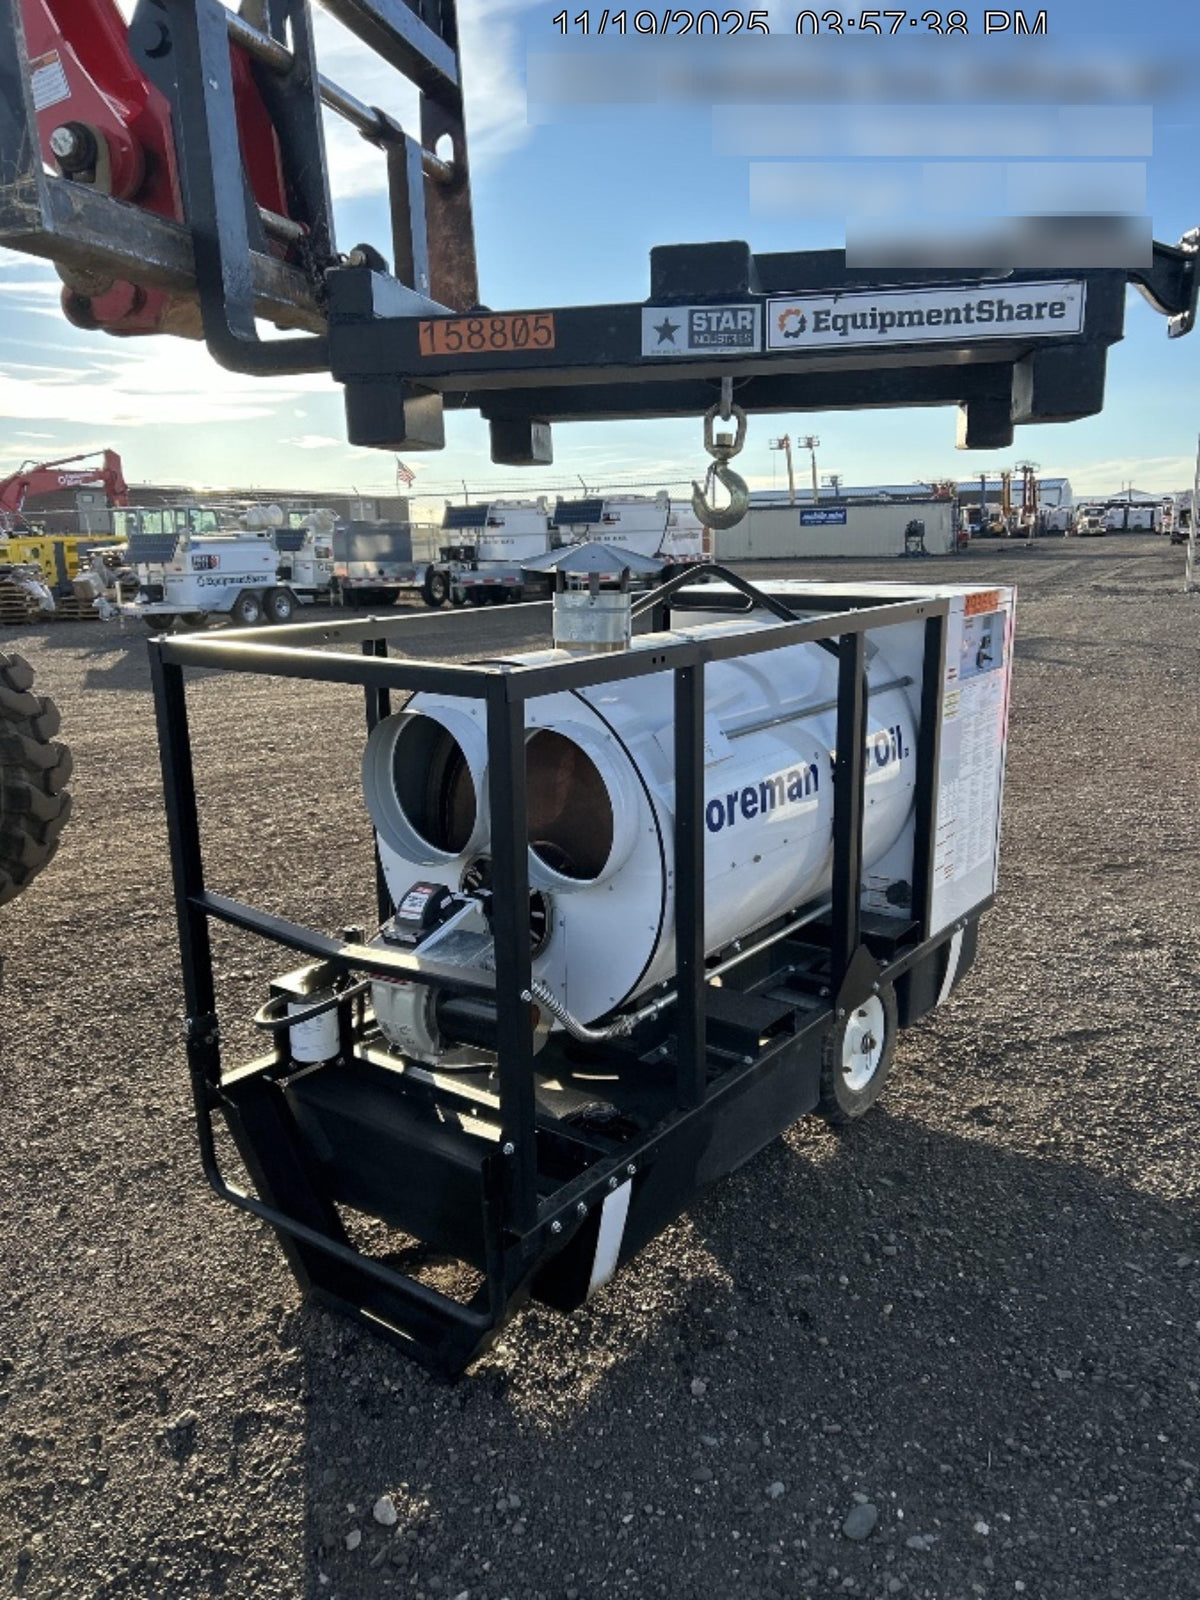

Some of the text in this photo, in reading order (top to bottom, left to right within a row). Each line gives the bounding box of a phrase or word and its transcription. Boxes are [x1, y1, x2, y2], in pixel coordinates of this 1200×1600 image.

[423, 315, 552, 353] 158805
[692, 310, 753, 332] STAR
[812, 299, 1066, 336] EquipmentShare
[705, 763, 819, 832] oreman
